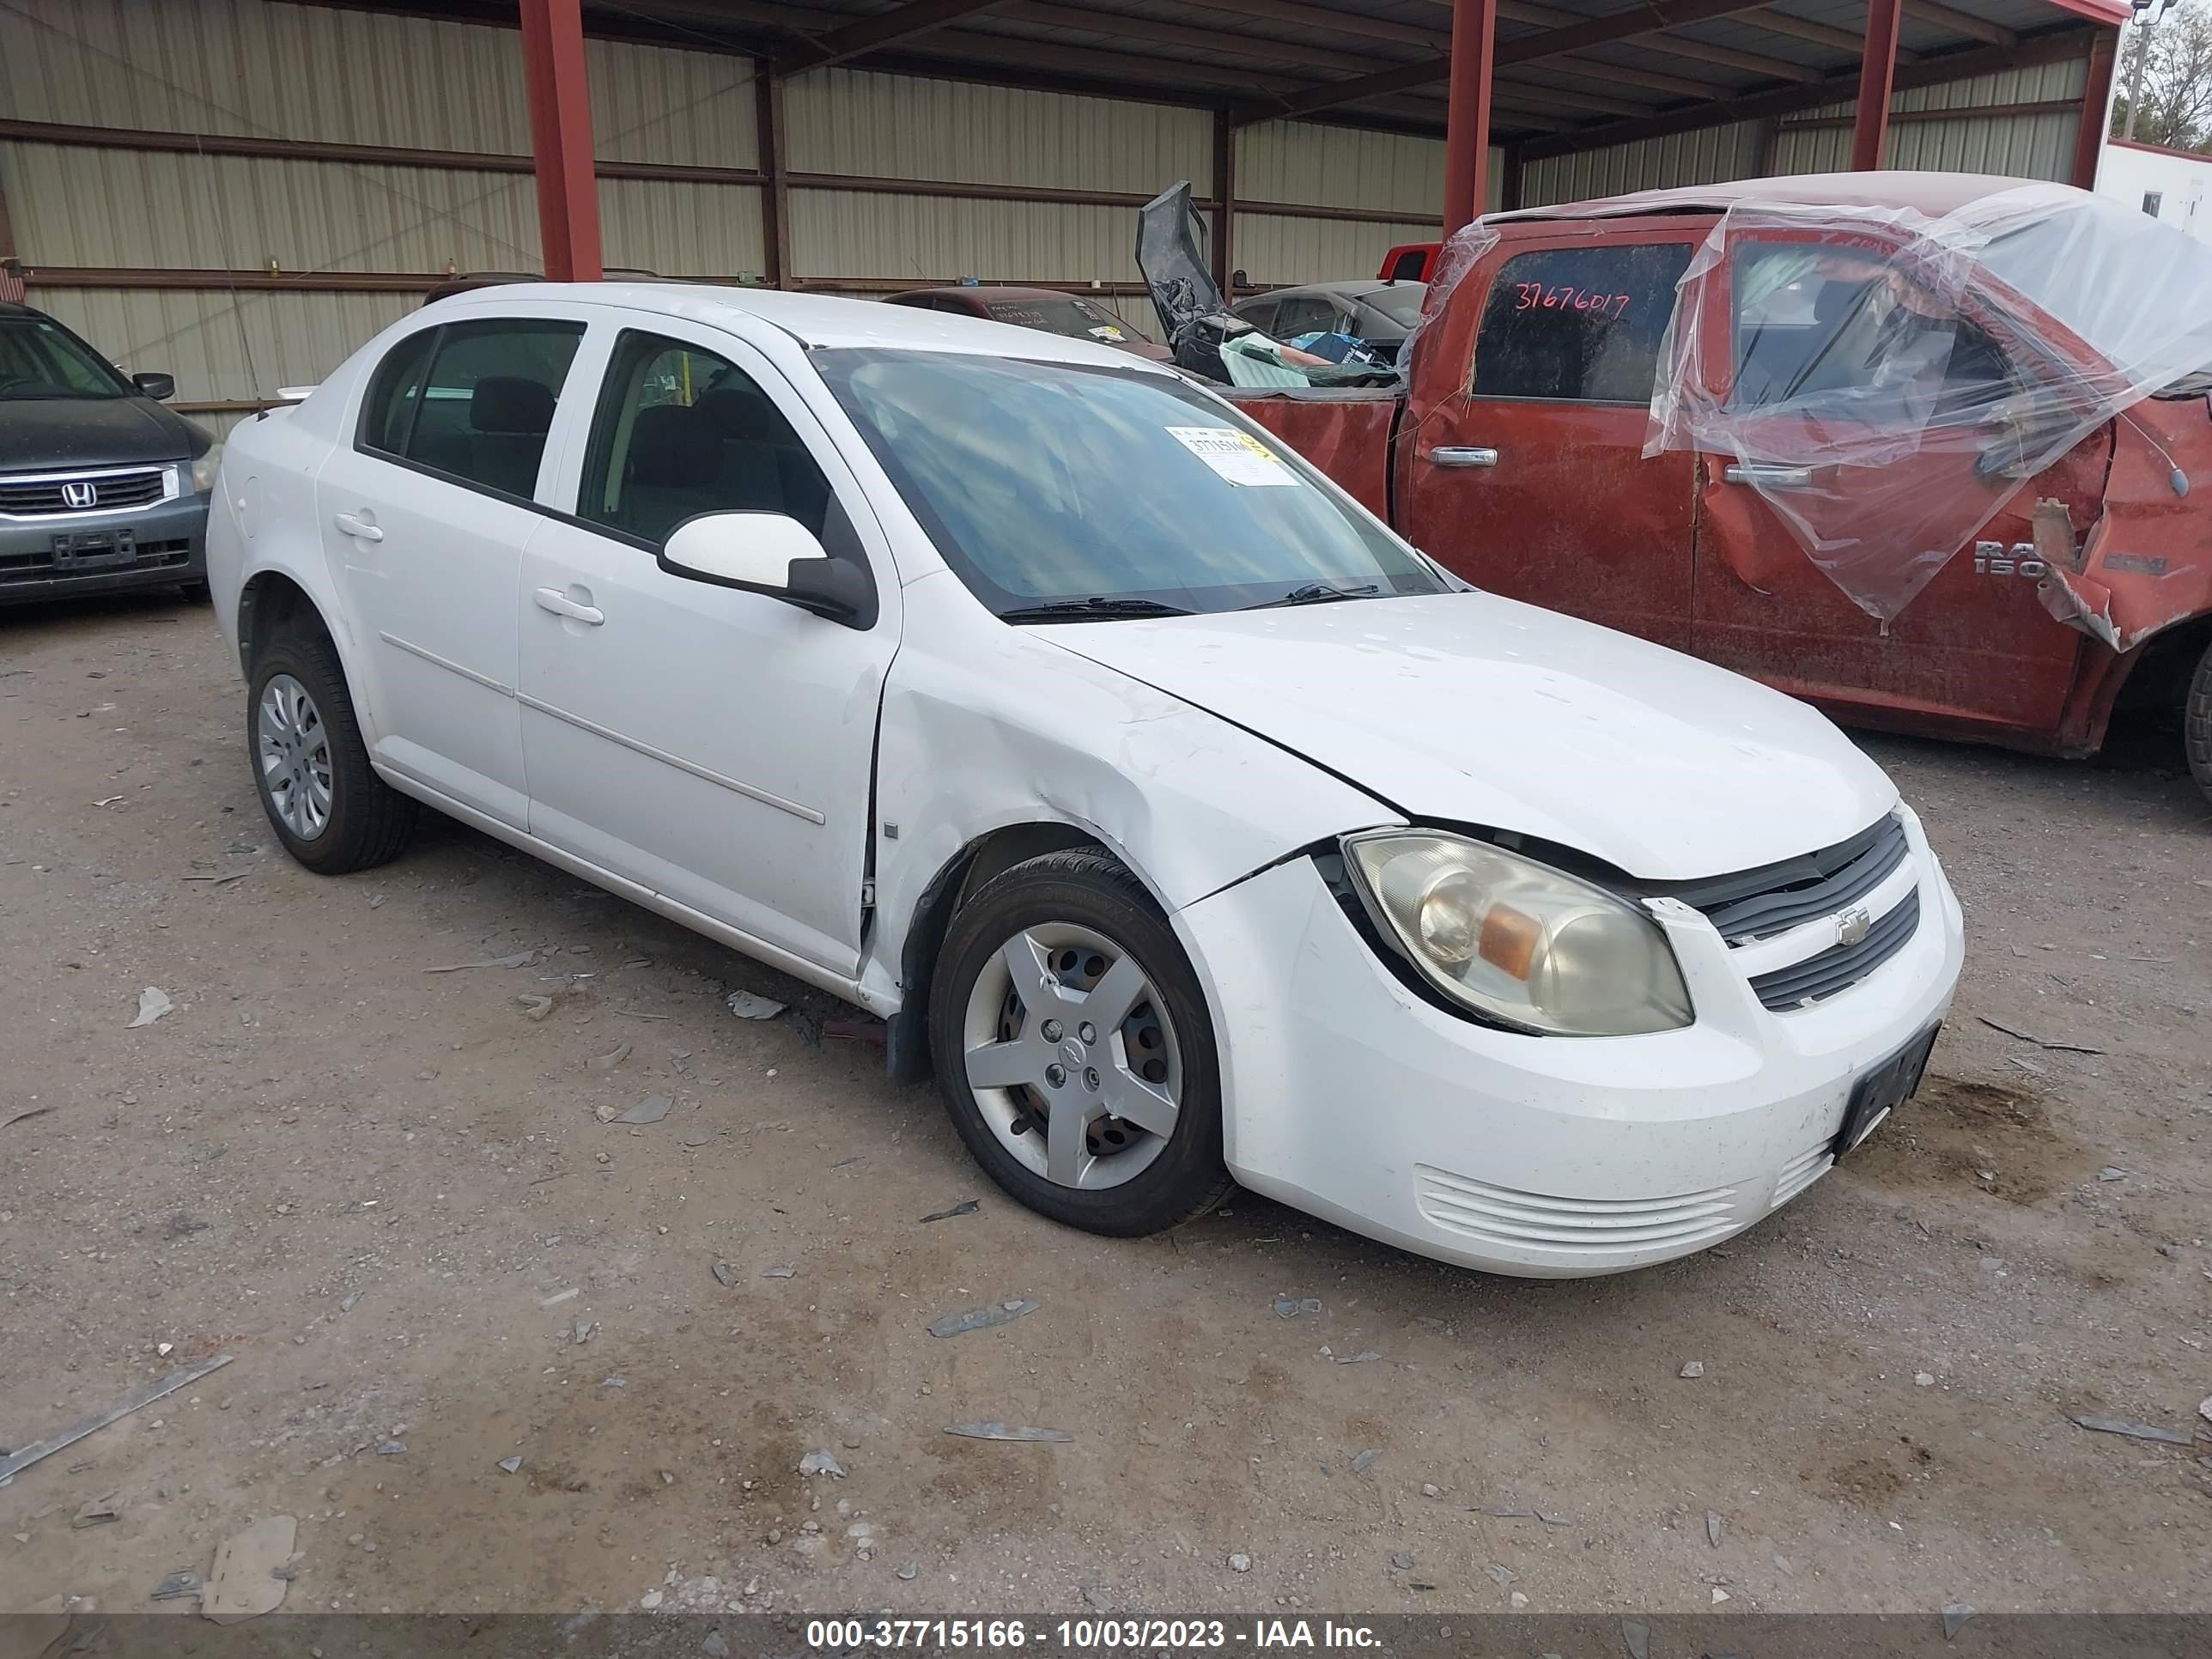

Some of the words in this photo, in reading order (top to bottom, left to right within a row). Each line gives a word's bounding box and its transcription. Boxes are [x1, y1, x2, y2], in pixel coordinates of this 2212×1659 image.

[1515, 283, 1630, 321] 37676017
[1974, 540, 2040, 558] RA
[1973, 558, 2047, 578] 150
